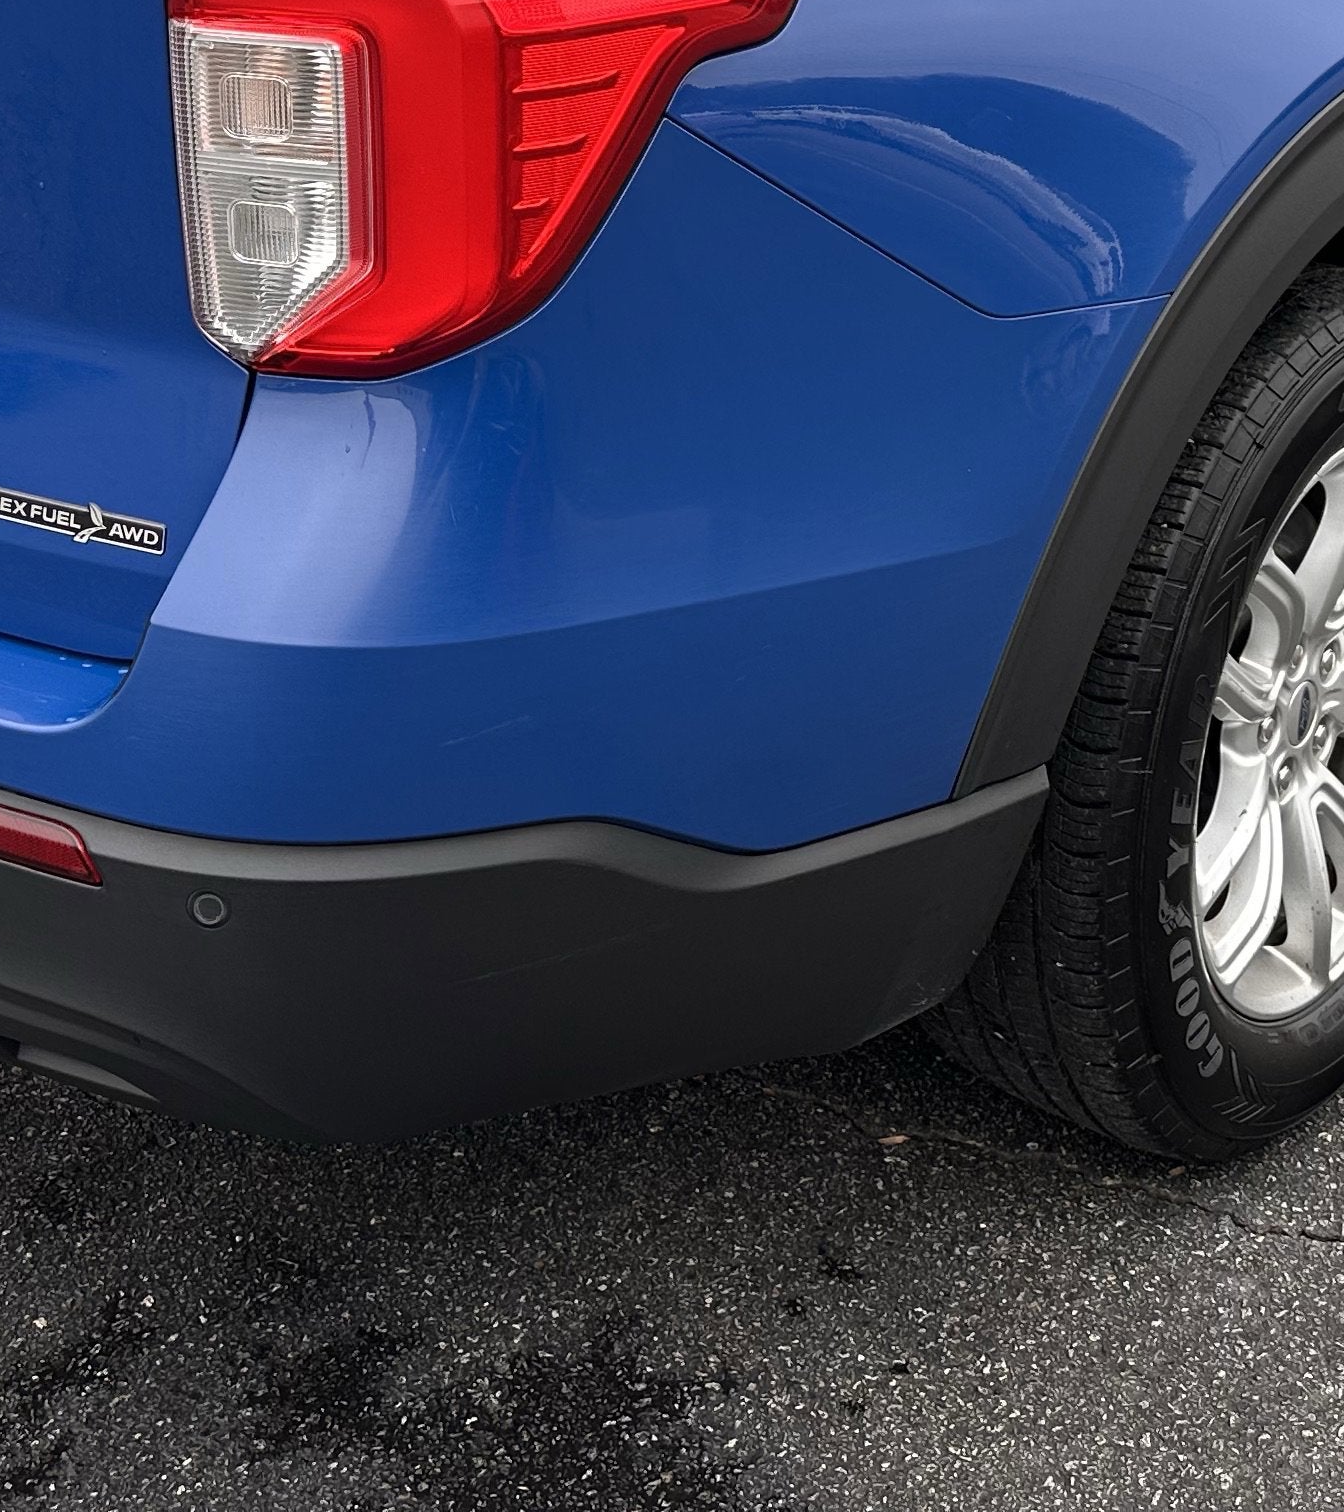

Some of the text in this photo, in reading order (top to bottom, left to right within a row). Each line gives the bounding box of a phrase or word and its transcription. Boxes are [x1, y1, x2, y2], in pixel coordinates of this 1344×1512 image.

[30, 505, 82, 530] FUEL
[108, 523, 159, 546] AWD
[1165, 673, 1225, 1078] GOODYEAR
